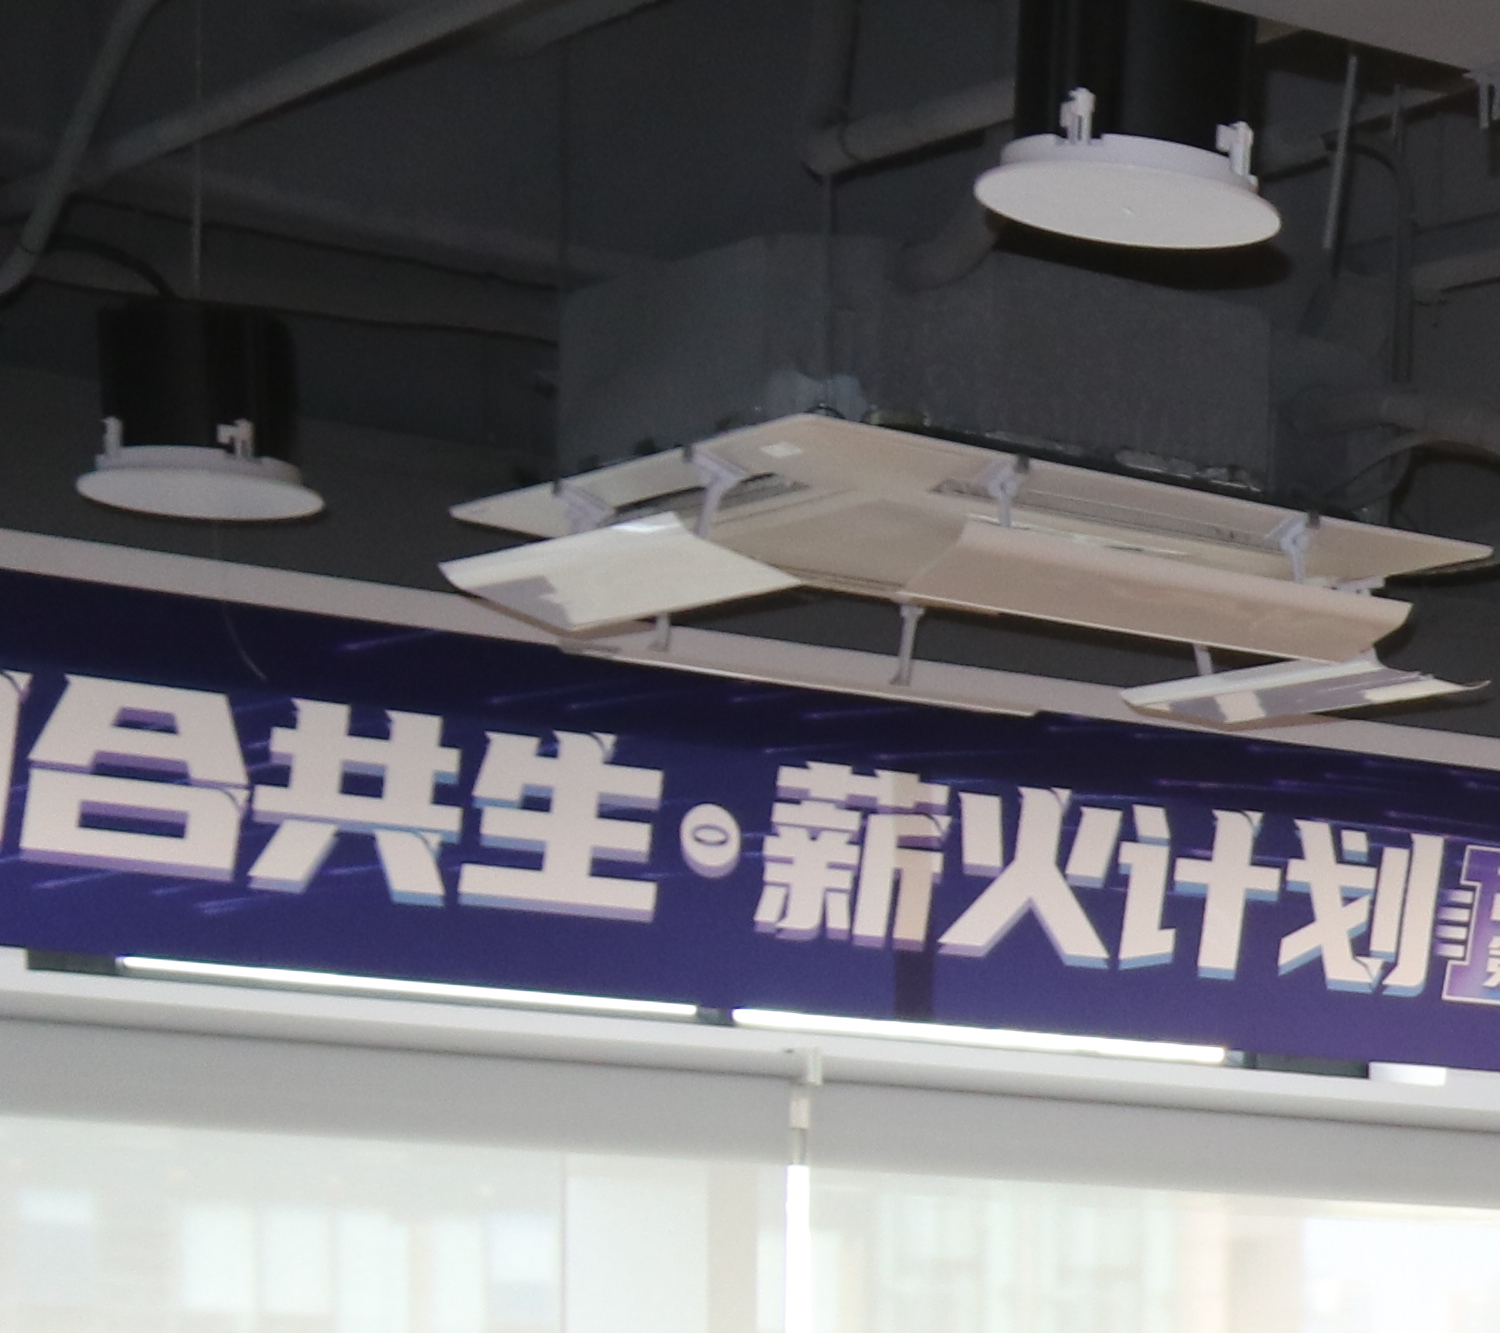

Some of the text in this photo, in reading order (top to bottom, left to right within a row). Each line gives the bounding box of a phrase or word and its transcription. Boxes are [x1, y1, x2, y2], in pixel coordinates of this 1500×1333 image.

[0, 671, 1446, 996] 合共生·薪火计划
